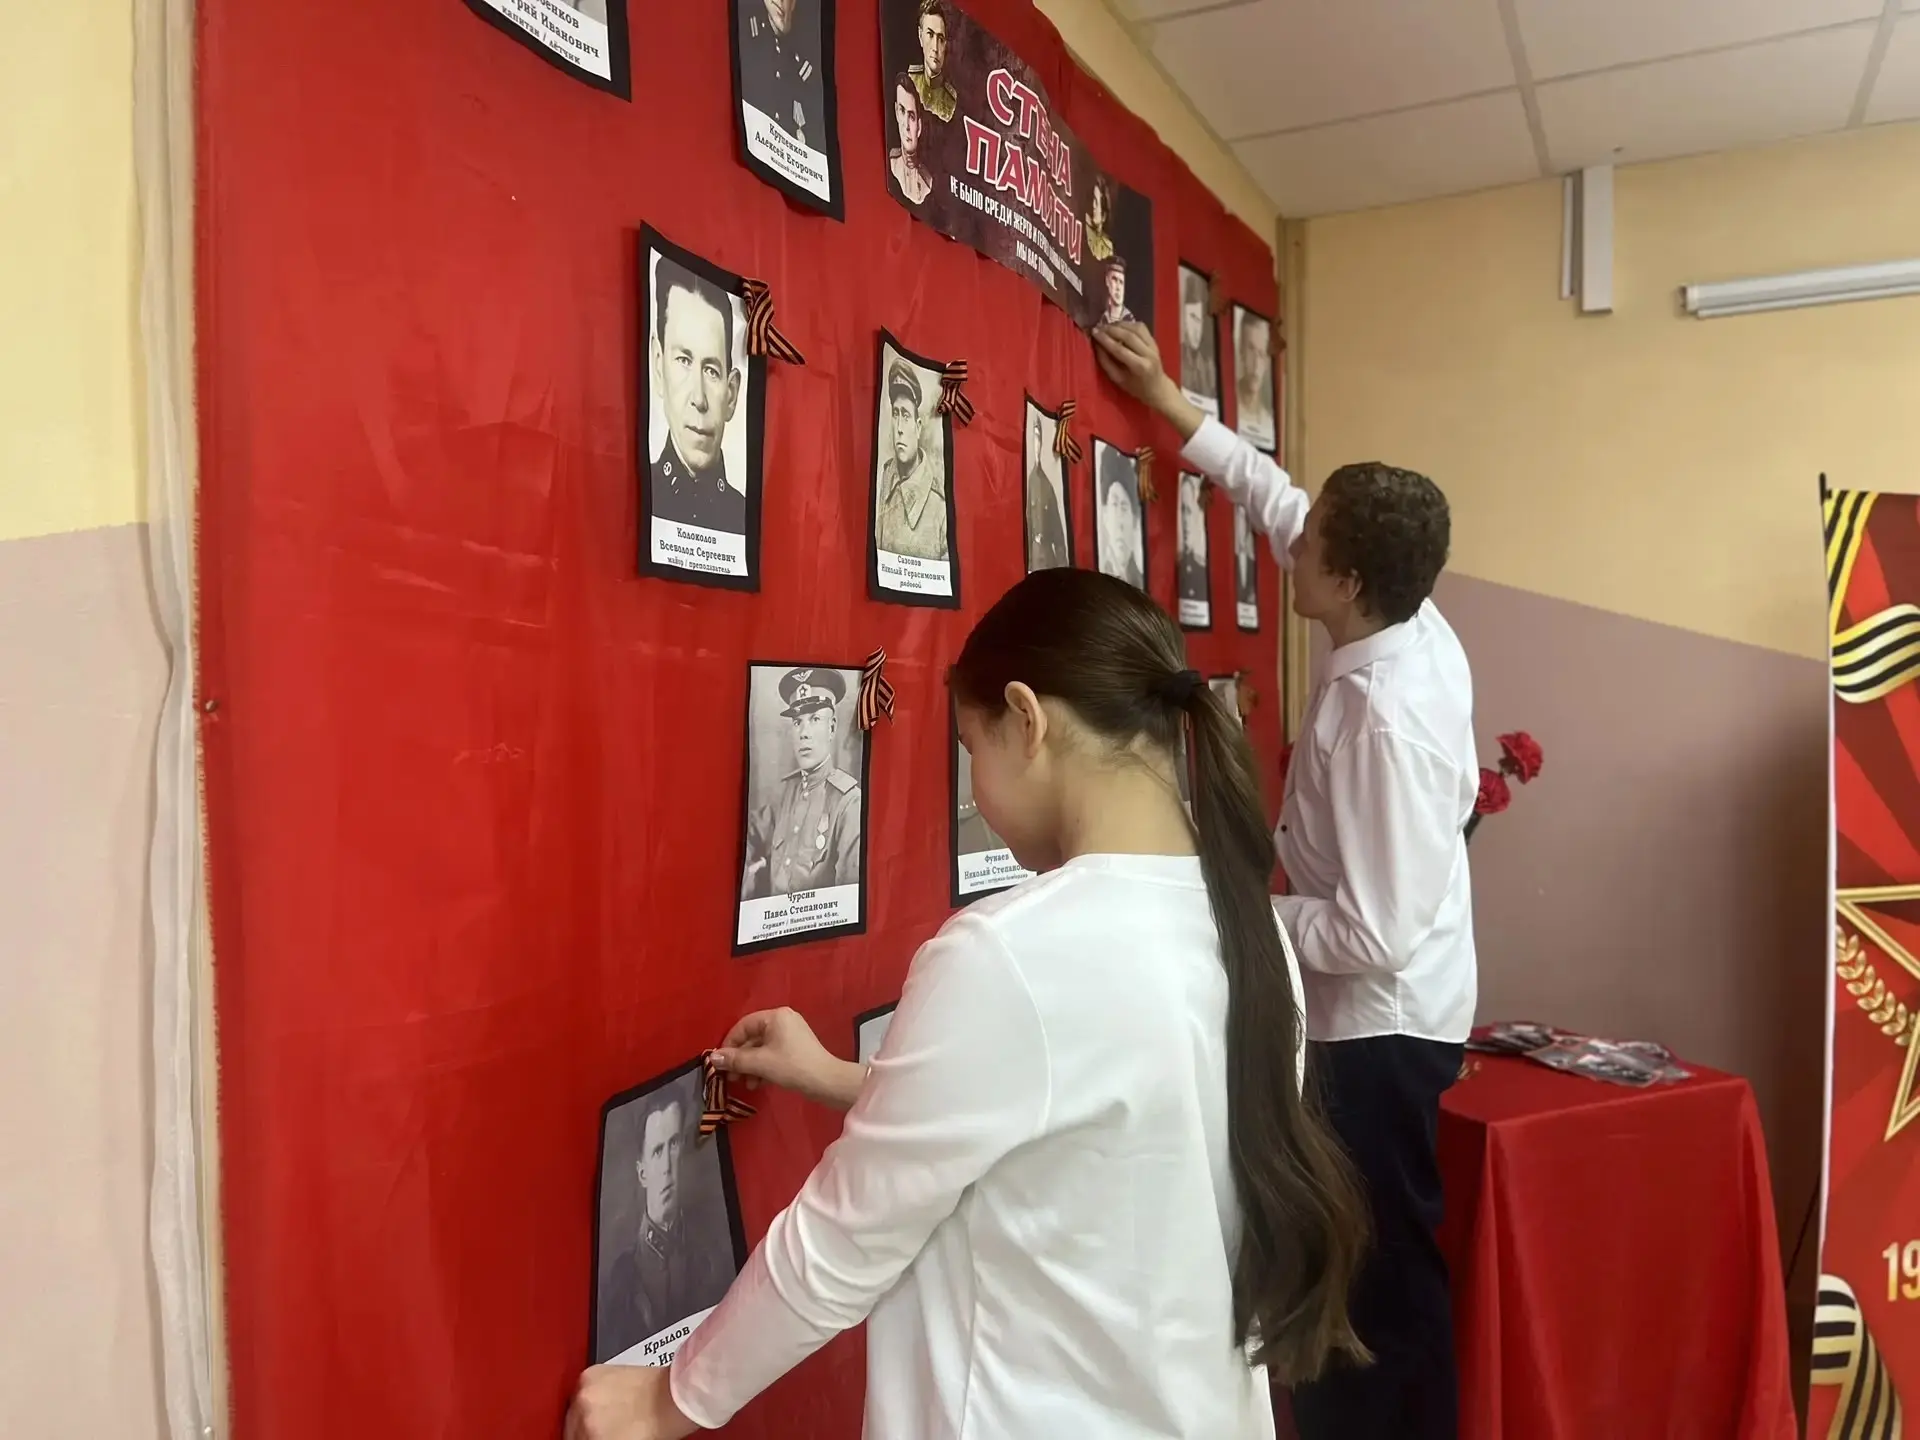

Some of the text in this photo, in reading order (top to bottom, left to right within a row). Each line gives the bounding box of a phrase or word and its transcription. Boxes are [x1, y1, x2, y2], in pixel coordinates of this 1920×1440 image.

[501, 5, 540, 37] капитан
[549, 40, 581, 65] лётчик
[540, 12, 600, 58] Иванович
[769, 123, 808, 159] Крупенков
[987, 67, 1073, 197] СТЕНА
[755, 131, 824, 183] Алексей Егорович
[963, 115, 1083, 266] ПАМЯТИ
[950, 174, 959, 198] НЕ
[959, 181, 984, 211] БЫЛО
[984, 195, 1013, 228] СРЕДИ
[1013, 211, 1033, 240] ЖЕРТВ
[1016, 239, 1028, 262] МЫ
[1027, 247, 1038, 271] ВАС
[677, 526, 717, 545] Колоколов
[659, 539, 736, 564] Всеволод Сергеевич
[667, 556, 684, 568] майор
[689, 561, 731, 574] преподаватель
[897, 555, 922, 567] Сазонов
[881, 564, 946, 581] Николай Герасимович
[964, 864, 1023, 880] Николай Степано
[764, 901, 839, 920] Павел Степанович
[787, 891, 816, 903] Чурсин
[762, 920, 785, 930] Сержант
[643, 1326, 691, 1356] Крылов
